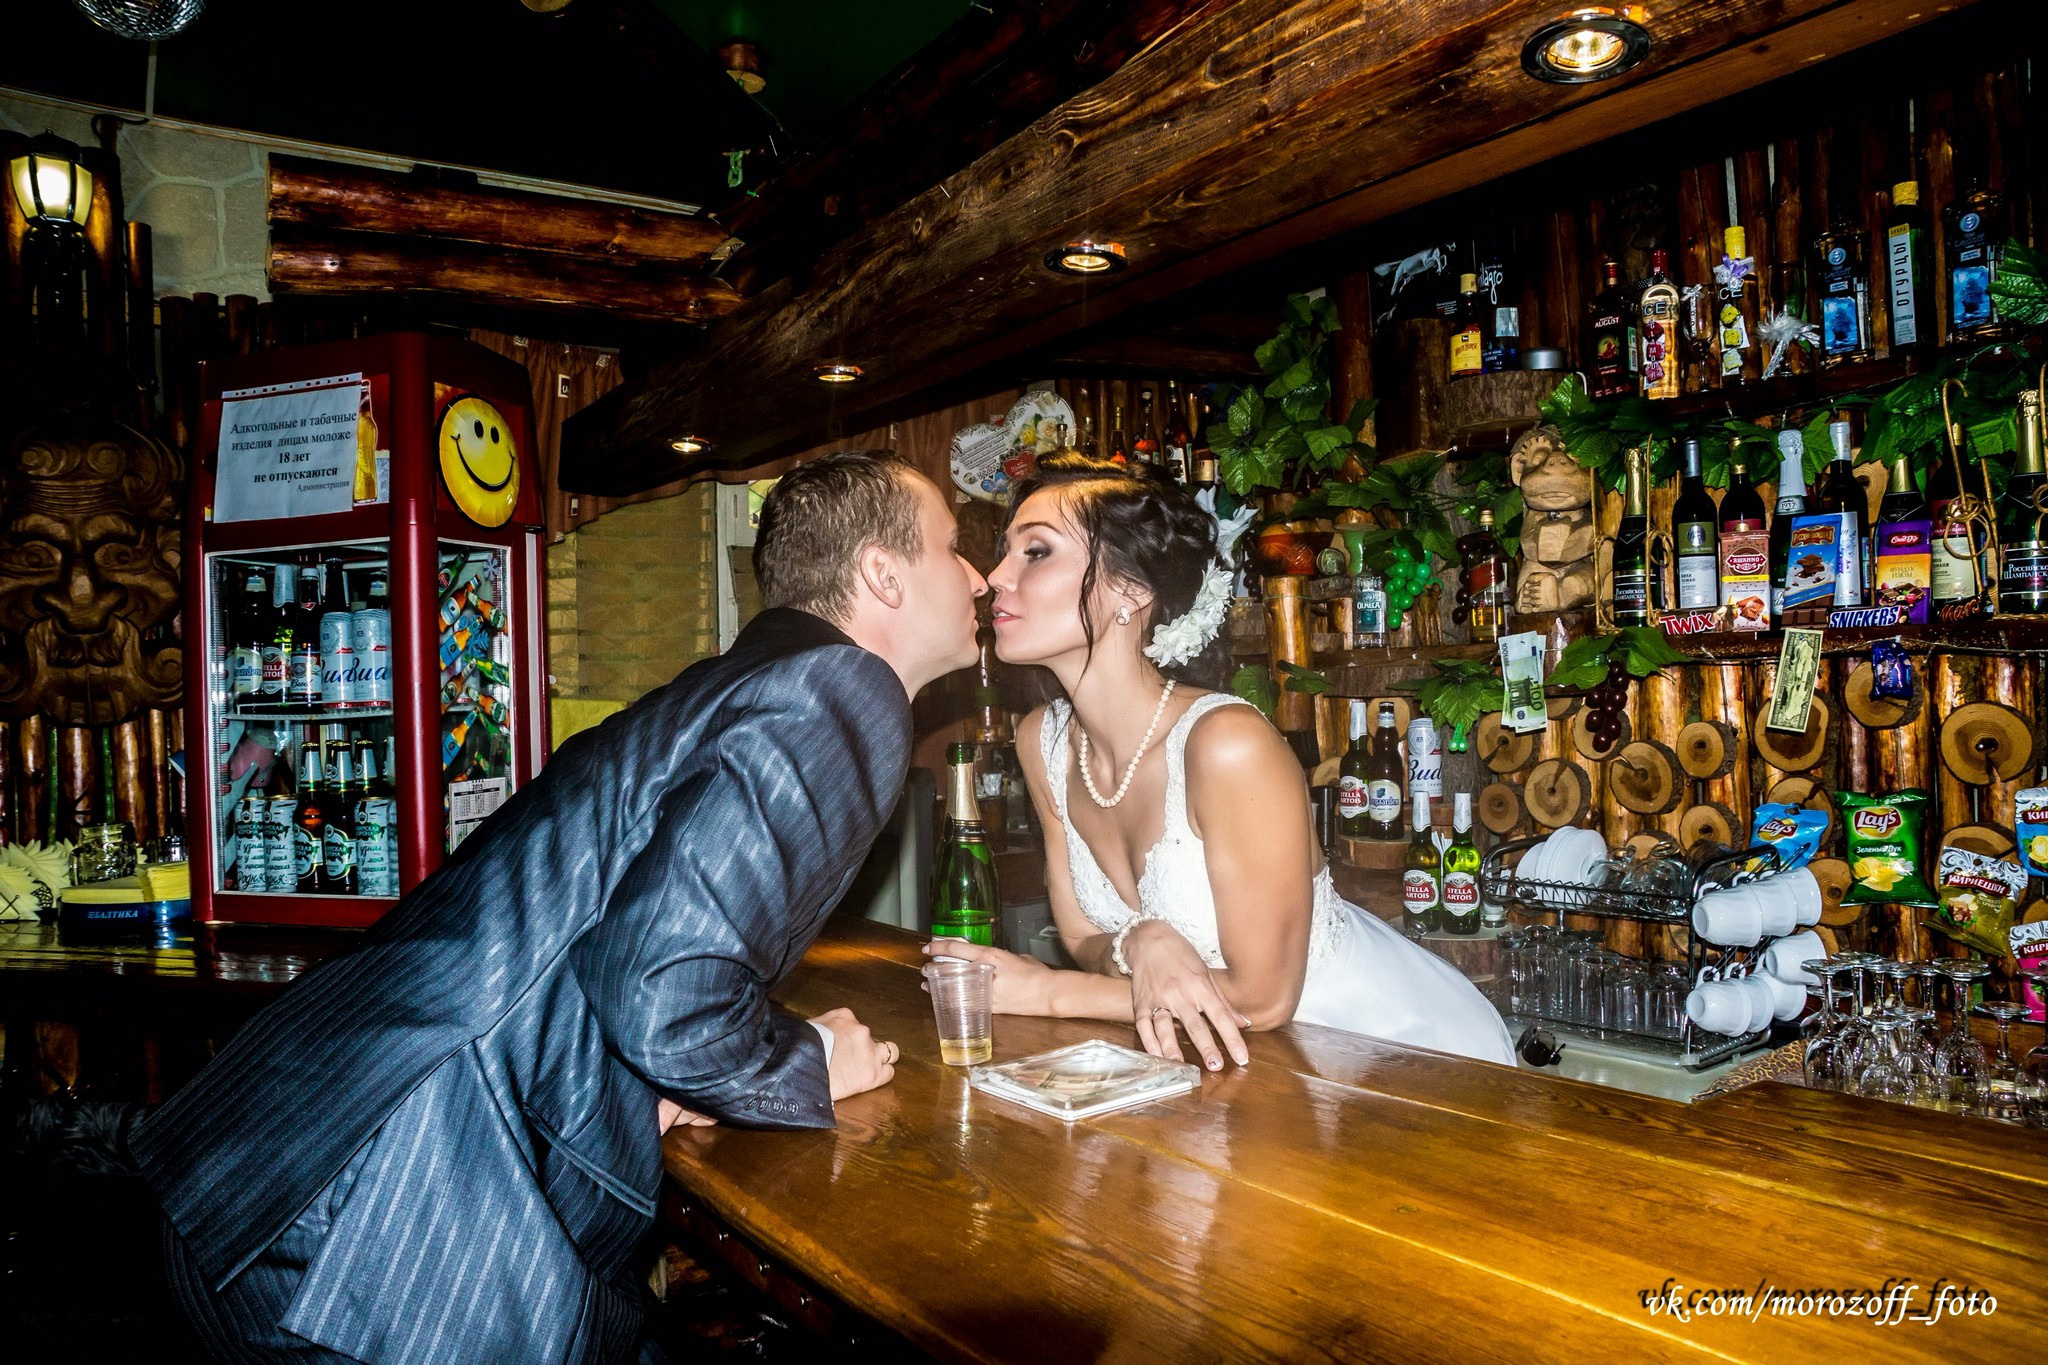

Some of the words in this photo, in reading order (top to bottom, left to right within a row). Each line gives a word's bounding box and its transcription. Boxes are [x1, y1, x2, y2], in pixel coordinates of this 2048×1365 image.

[1894, 242, 1910, 306] ОГУРЦЫ
[1594, 317, 1620, 328] AUGUST
[230, 420, 298, 434] Алкогольные
[310, 412, 356, 426] табачные
[232, 440, 272, 452] изделия
[277, 436, 308, 447] лицам
[312, 430, 351, 443] моложе
[279, 452, 290, 464] 18
[292, 452, 310, 462] лет
[254, 473, 266, 483] не
[269, 467, 338, 483] отпускаются
[296, 480, 350, 492] Администрация
[1829, 604, 1900, 628] SNICKERS
[1530, 684, 1543, 711] 100
[95, 910, 138, 918] БАЛТИКА
